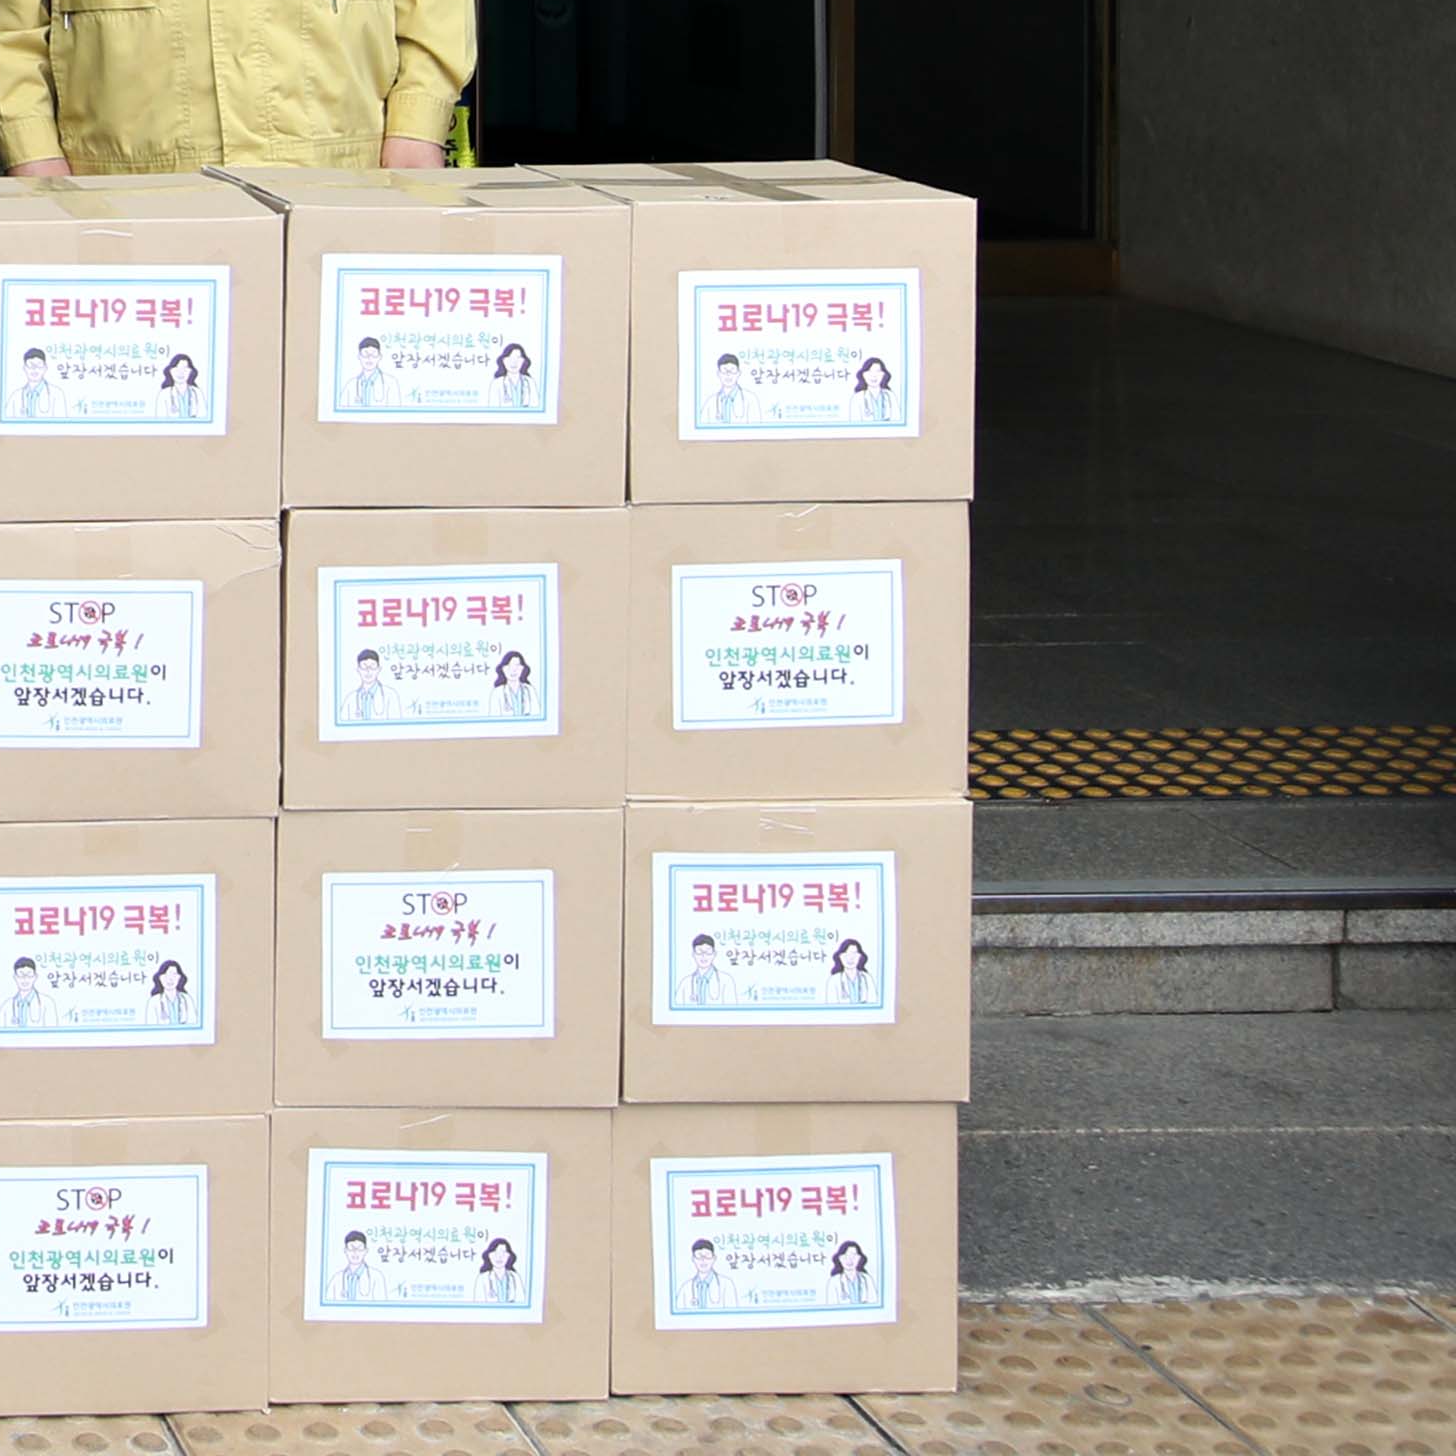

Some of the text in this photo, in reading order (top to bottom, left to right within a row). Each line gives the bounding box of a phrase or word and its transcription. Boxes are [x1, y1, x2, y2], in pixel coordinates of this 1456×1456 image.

[25, 298, 194, 328] 코로나19 극복!
[360, 287, 527, 317] 코로나19 극복!
[717, 301, 885, 334] 코로나19 극복!
[357, 594, 524, 629] 코로나19 극복!
[705, 643, 869, 667] 인천광역시의료원이
[0, 663, 166, 684] 인천광역시의료원이
[719, 668, 854, 690] 앞장서겠습니다.
[14, 687, 151, 707] 앞장서겠습니다.
[694, 881, 861, 914] 코로나19 극복!
[15, 903, 181, 937] 코로나19 극복!
[355, 953, 519, 975] 인천광역시의료원이
[369, 977, 505, 998] 앞장서겠습니다.
[346, 1181, 513, 1212] 코로나19 극복!
[691, 1184, 860, 1219] 코로나19 극복!
[8, 1248, 173, 1270] 인천광역시의료원이
[23, 1271, 158, 1293] 앞장서겠습니다.
